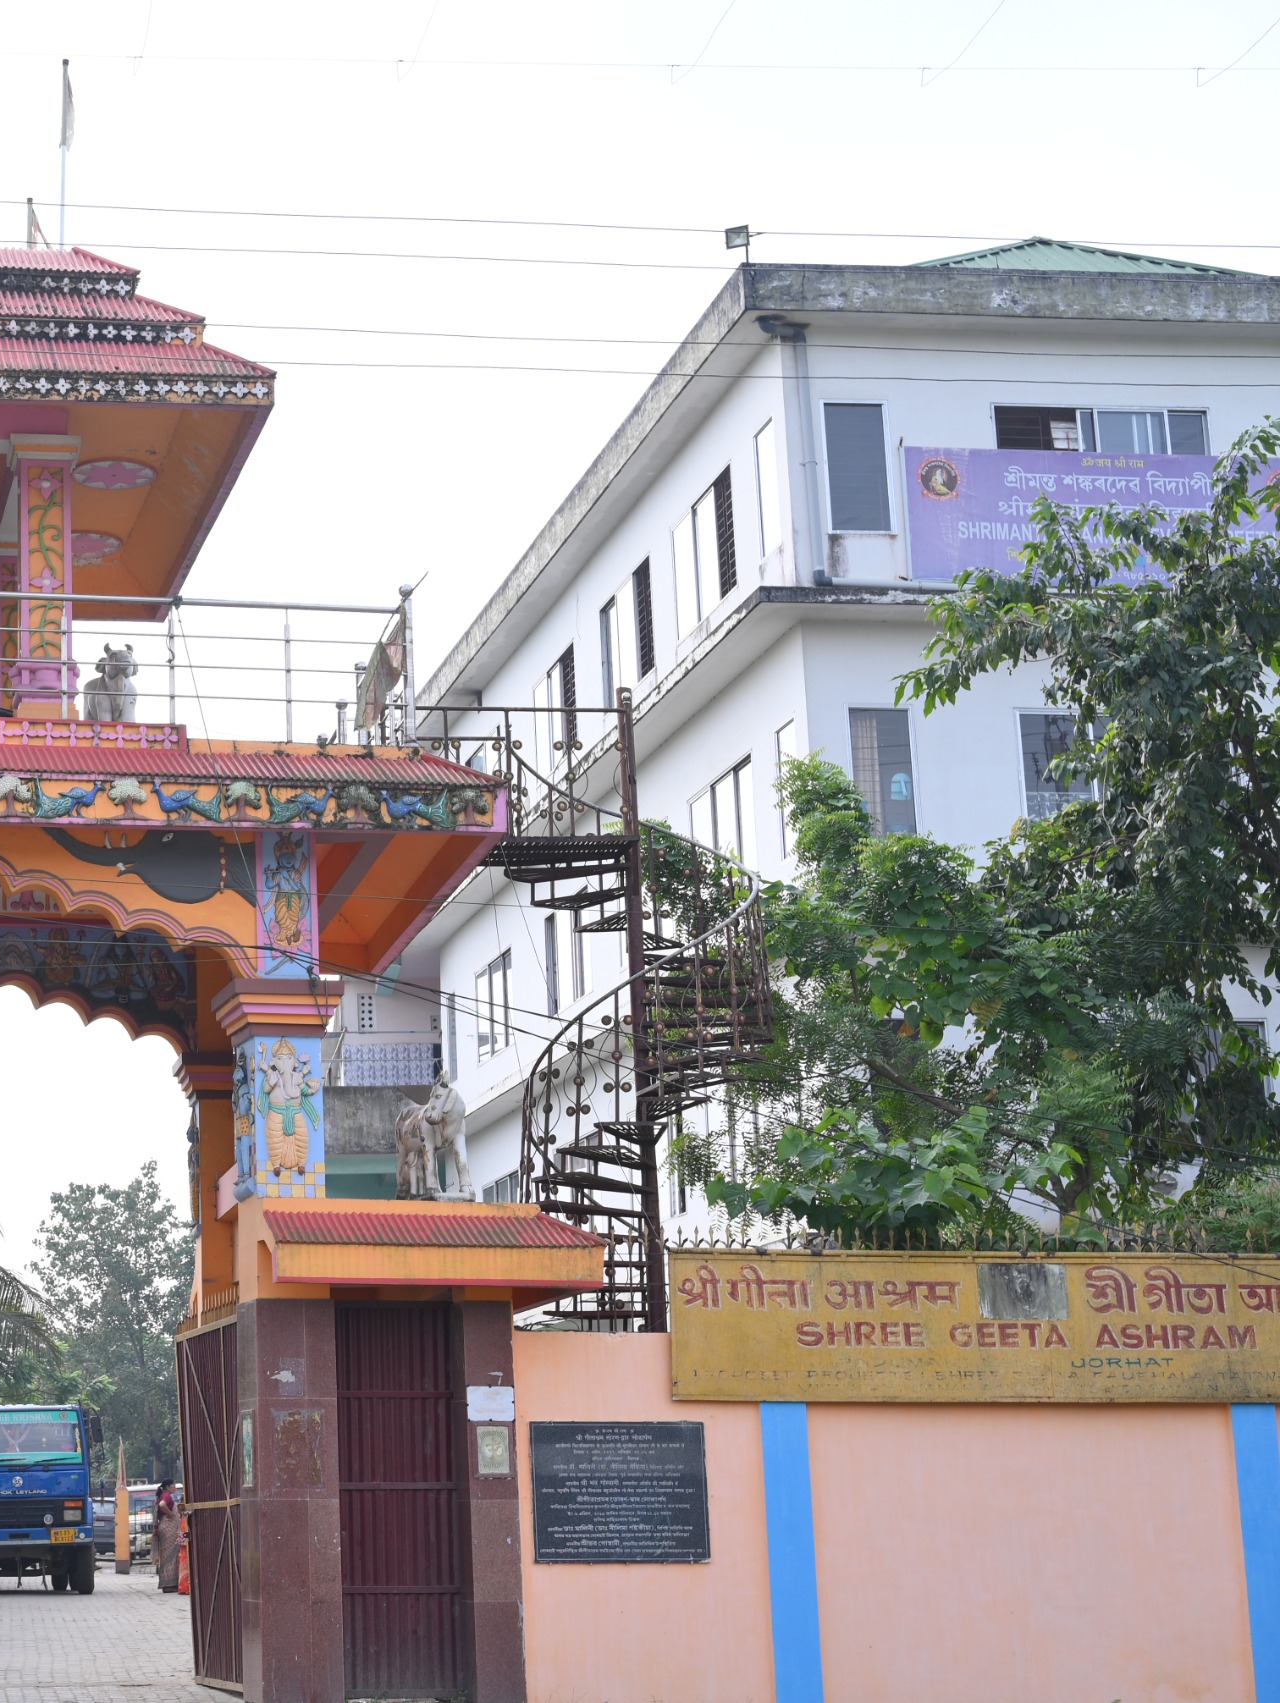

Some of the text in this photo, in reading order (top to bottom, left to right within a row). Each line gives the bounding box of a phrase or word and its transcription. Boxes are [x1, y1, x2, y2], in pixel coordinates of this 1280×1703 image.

[1145, 470, 1220, 497] বিদ্যাপী
[677, 1263, 961, 1312] श्री गीता आश्रम
[1085, 1265, 1138, 1314] শ্ৰী
[1143, 1265, 1227, 1315] গীতা
[796, 1321, 1259, 1351] SHREE GEETA ASHRAM
[1071, 1357, 1174, 1369] JORHAT
[14, 1413, 52, 1421] KRISHNA
